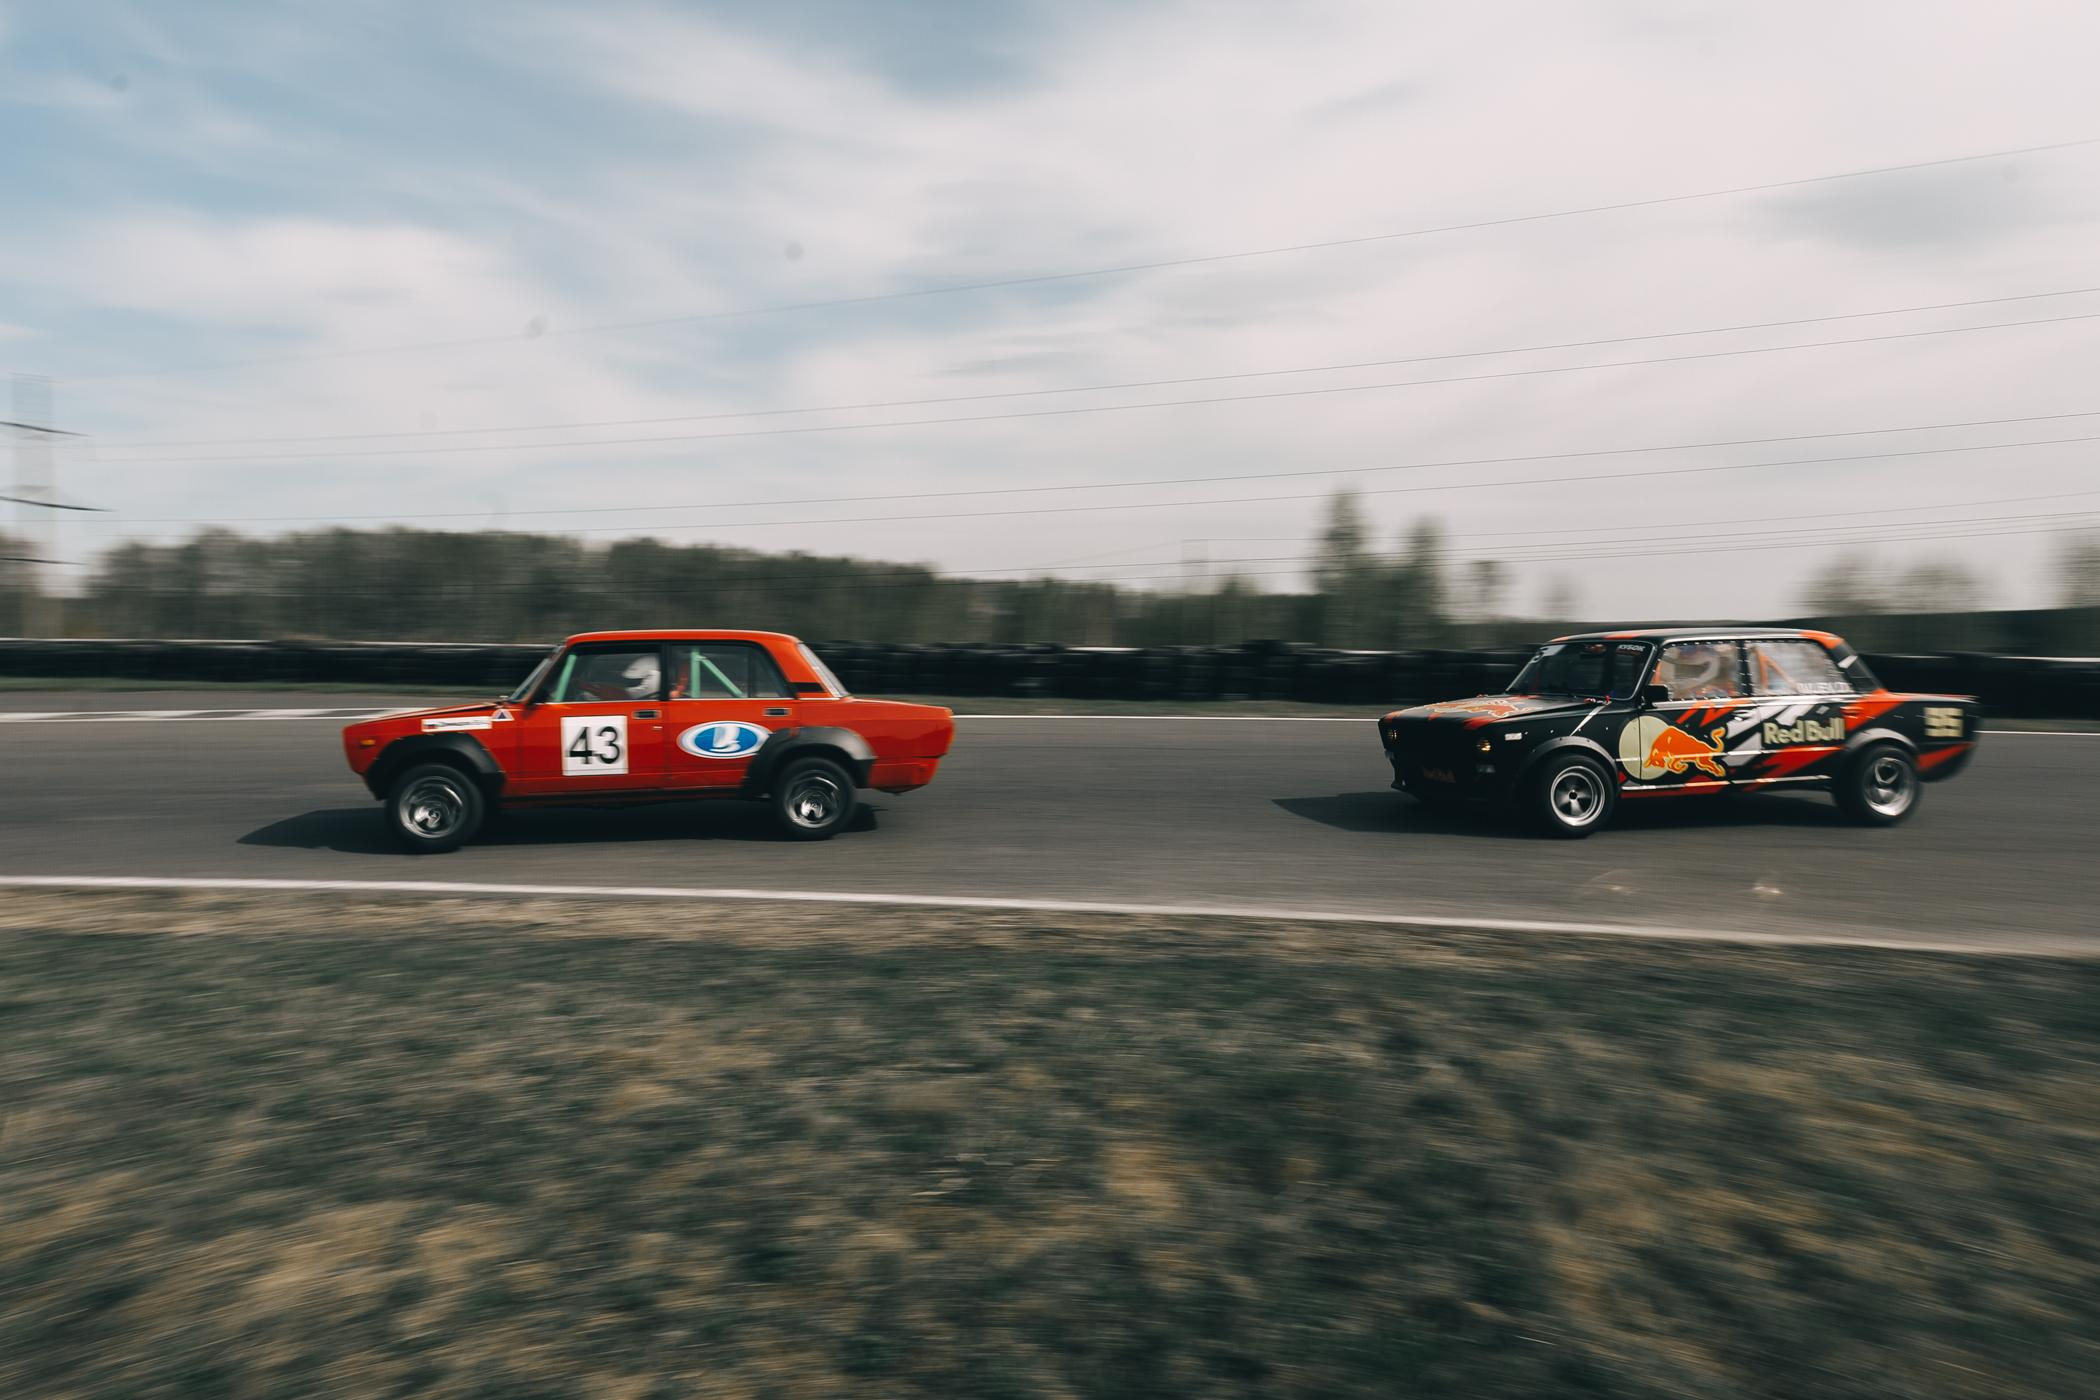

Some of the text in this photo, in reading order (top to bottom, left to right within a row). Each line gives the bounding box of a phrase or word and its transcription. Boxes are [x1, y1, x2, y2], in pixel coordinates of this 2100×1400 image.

[566, 725, 622, 765] 43
[1763, 717, 1845, 744] Red Bull
